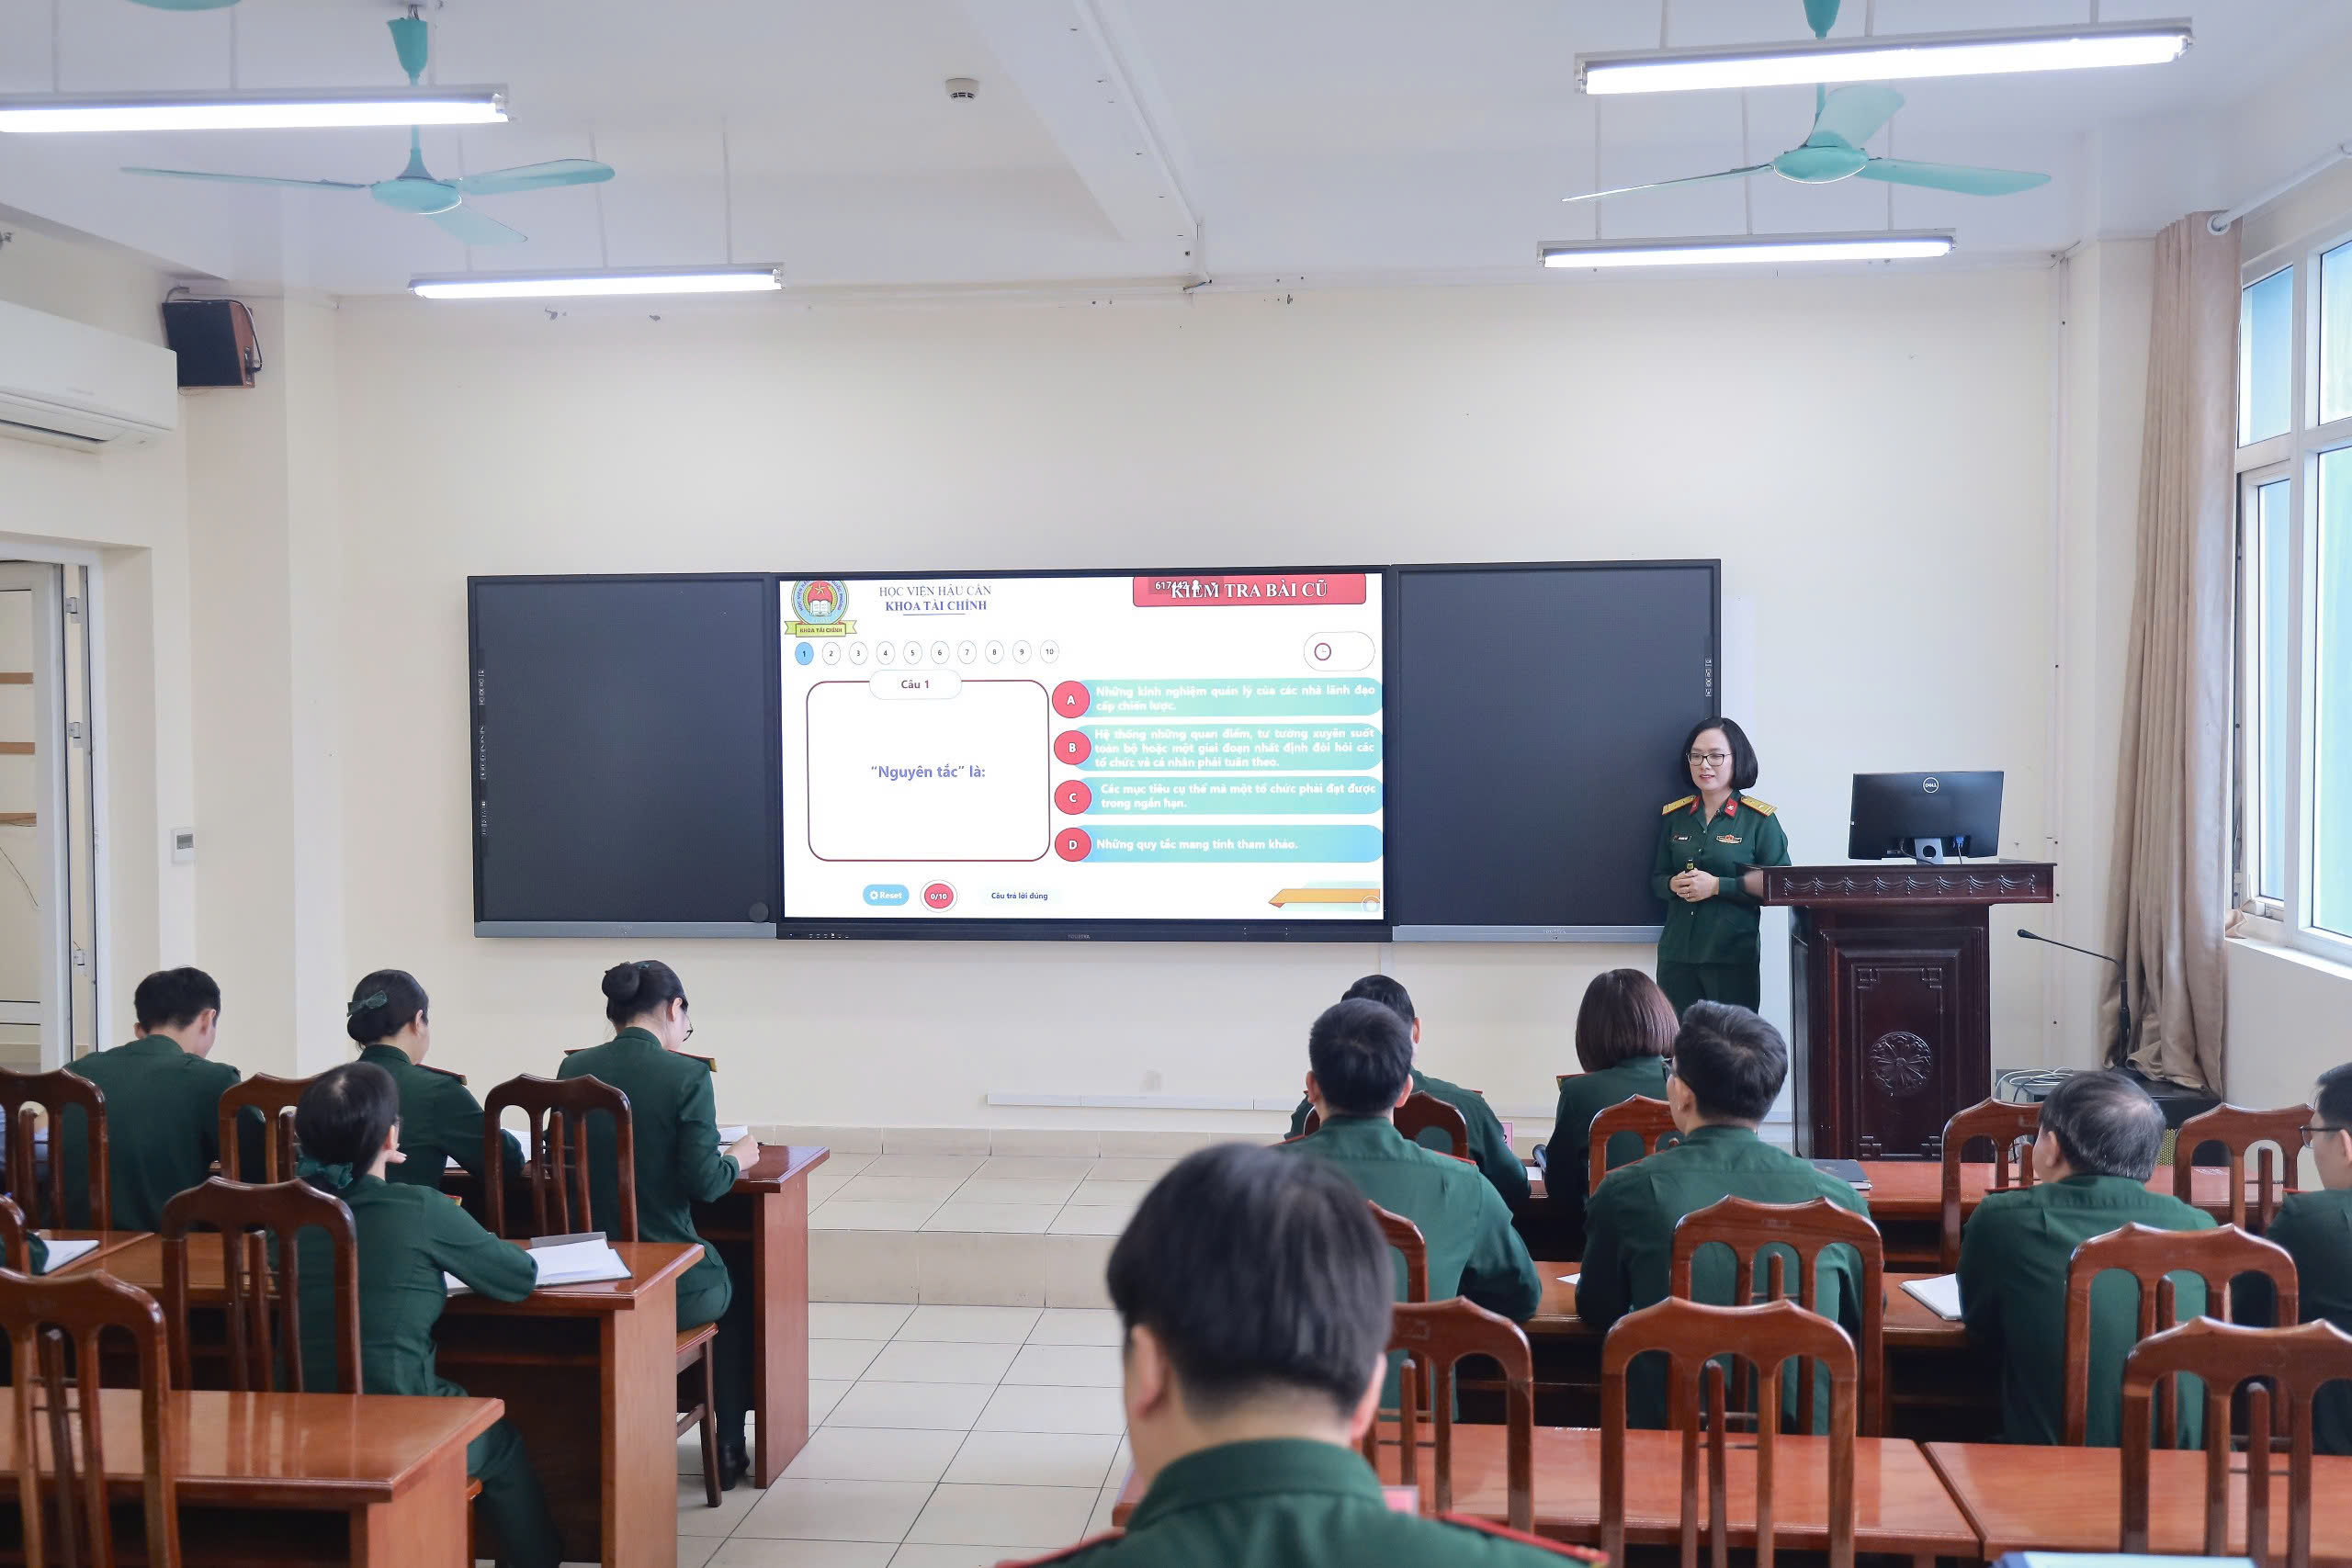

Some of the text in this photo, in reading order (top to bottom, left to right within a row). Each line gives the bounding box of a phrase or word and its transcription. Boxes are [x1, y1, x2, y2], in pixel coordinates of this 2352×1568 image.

[879, 586, 903, 597] HỌC
[907, 585, 933, 598] VIỆN
[937, 584, 965, 597] HẬU
[1224, 581, 1261, 598] TRA
[1266, 579, 1296, 596] BÀI
[1302, 579, 1328, 596] CŨ
[886, 600, 987, 611] KHOA TÀI CHÍNH
[901, 679, 930, 689] Câu 1
[1096, 686, 1133, 698] Những
[1137, 686, 1161, 696] kinh
[1166, 686, 1206, 698] nghiệm
[1242, 685, 1251, 698] lý
[1280, 685, 1297, 695] các
[1327, 685, 1350, 694] lãnh
[1354, 684, 1374, 696] đạo
[1067, 695, 1075, 705] A
[1095, 729, 1110, 740] Hệ
[1151, 729, 1186, 741] những
[1191, 730, 1217, 740] quan
[1258, 729, 1270, 738] tư
[1313, 728, 1345, 740] xuyên
[1069, 743, 1076, 752] B
[1124, 743, 1137, 754] bộ
[1172, 744, 1193, 754] một
[1198, 743, 1218, 754] giai
[1223, 742, 1250, 754] đoạn
[1283, 742, 1308, 754] định
[1357, 742, 1374, 751] các
[1110, 757, 1135, 767] chức
[1169, 757, 1194, 767] nhân
[1252, 757, 1279, 767] theo.
[871, 764, 986, 781] “Nguyên tắc” là:
[1101, 784, 1120, 794] Các
[1124, 785, 1146, 795] mục
[1149, 784, 1170, 794] tiêu
[1173, 785, 1185, 795] cụ
[1230, 784, 1252, 795] một
[1270, 784, 1295, 794] chức
[1327, 784, 1344, 795] đạt
[1348, 784, 1376, 795] được
[1069, 793, 1077, 802] C
[1102, 799, 1131, 810] trong
[1164, 797, 1187, 808] hạn.
[1069, 840, 1077, 850] D
[1097, 839, 1134, 851] Những
[1136, 840, 1157, 852] quy
[1180, 840, 1209, 852] mang
[1213, 839, 1234, 849] tính
[1238, 839, 1265, 849] tham
[1029, 892, 1048, 901] đúng
